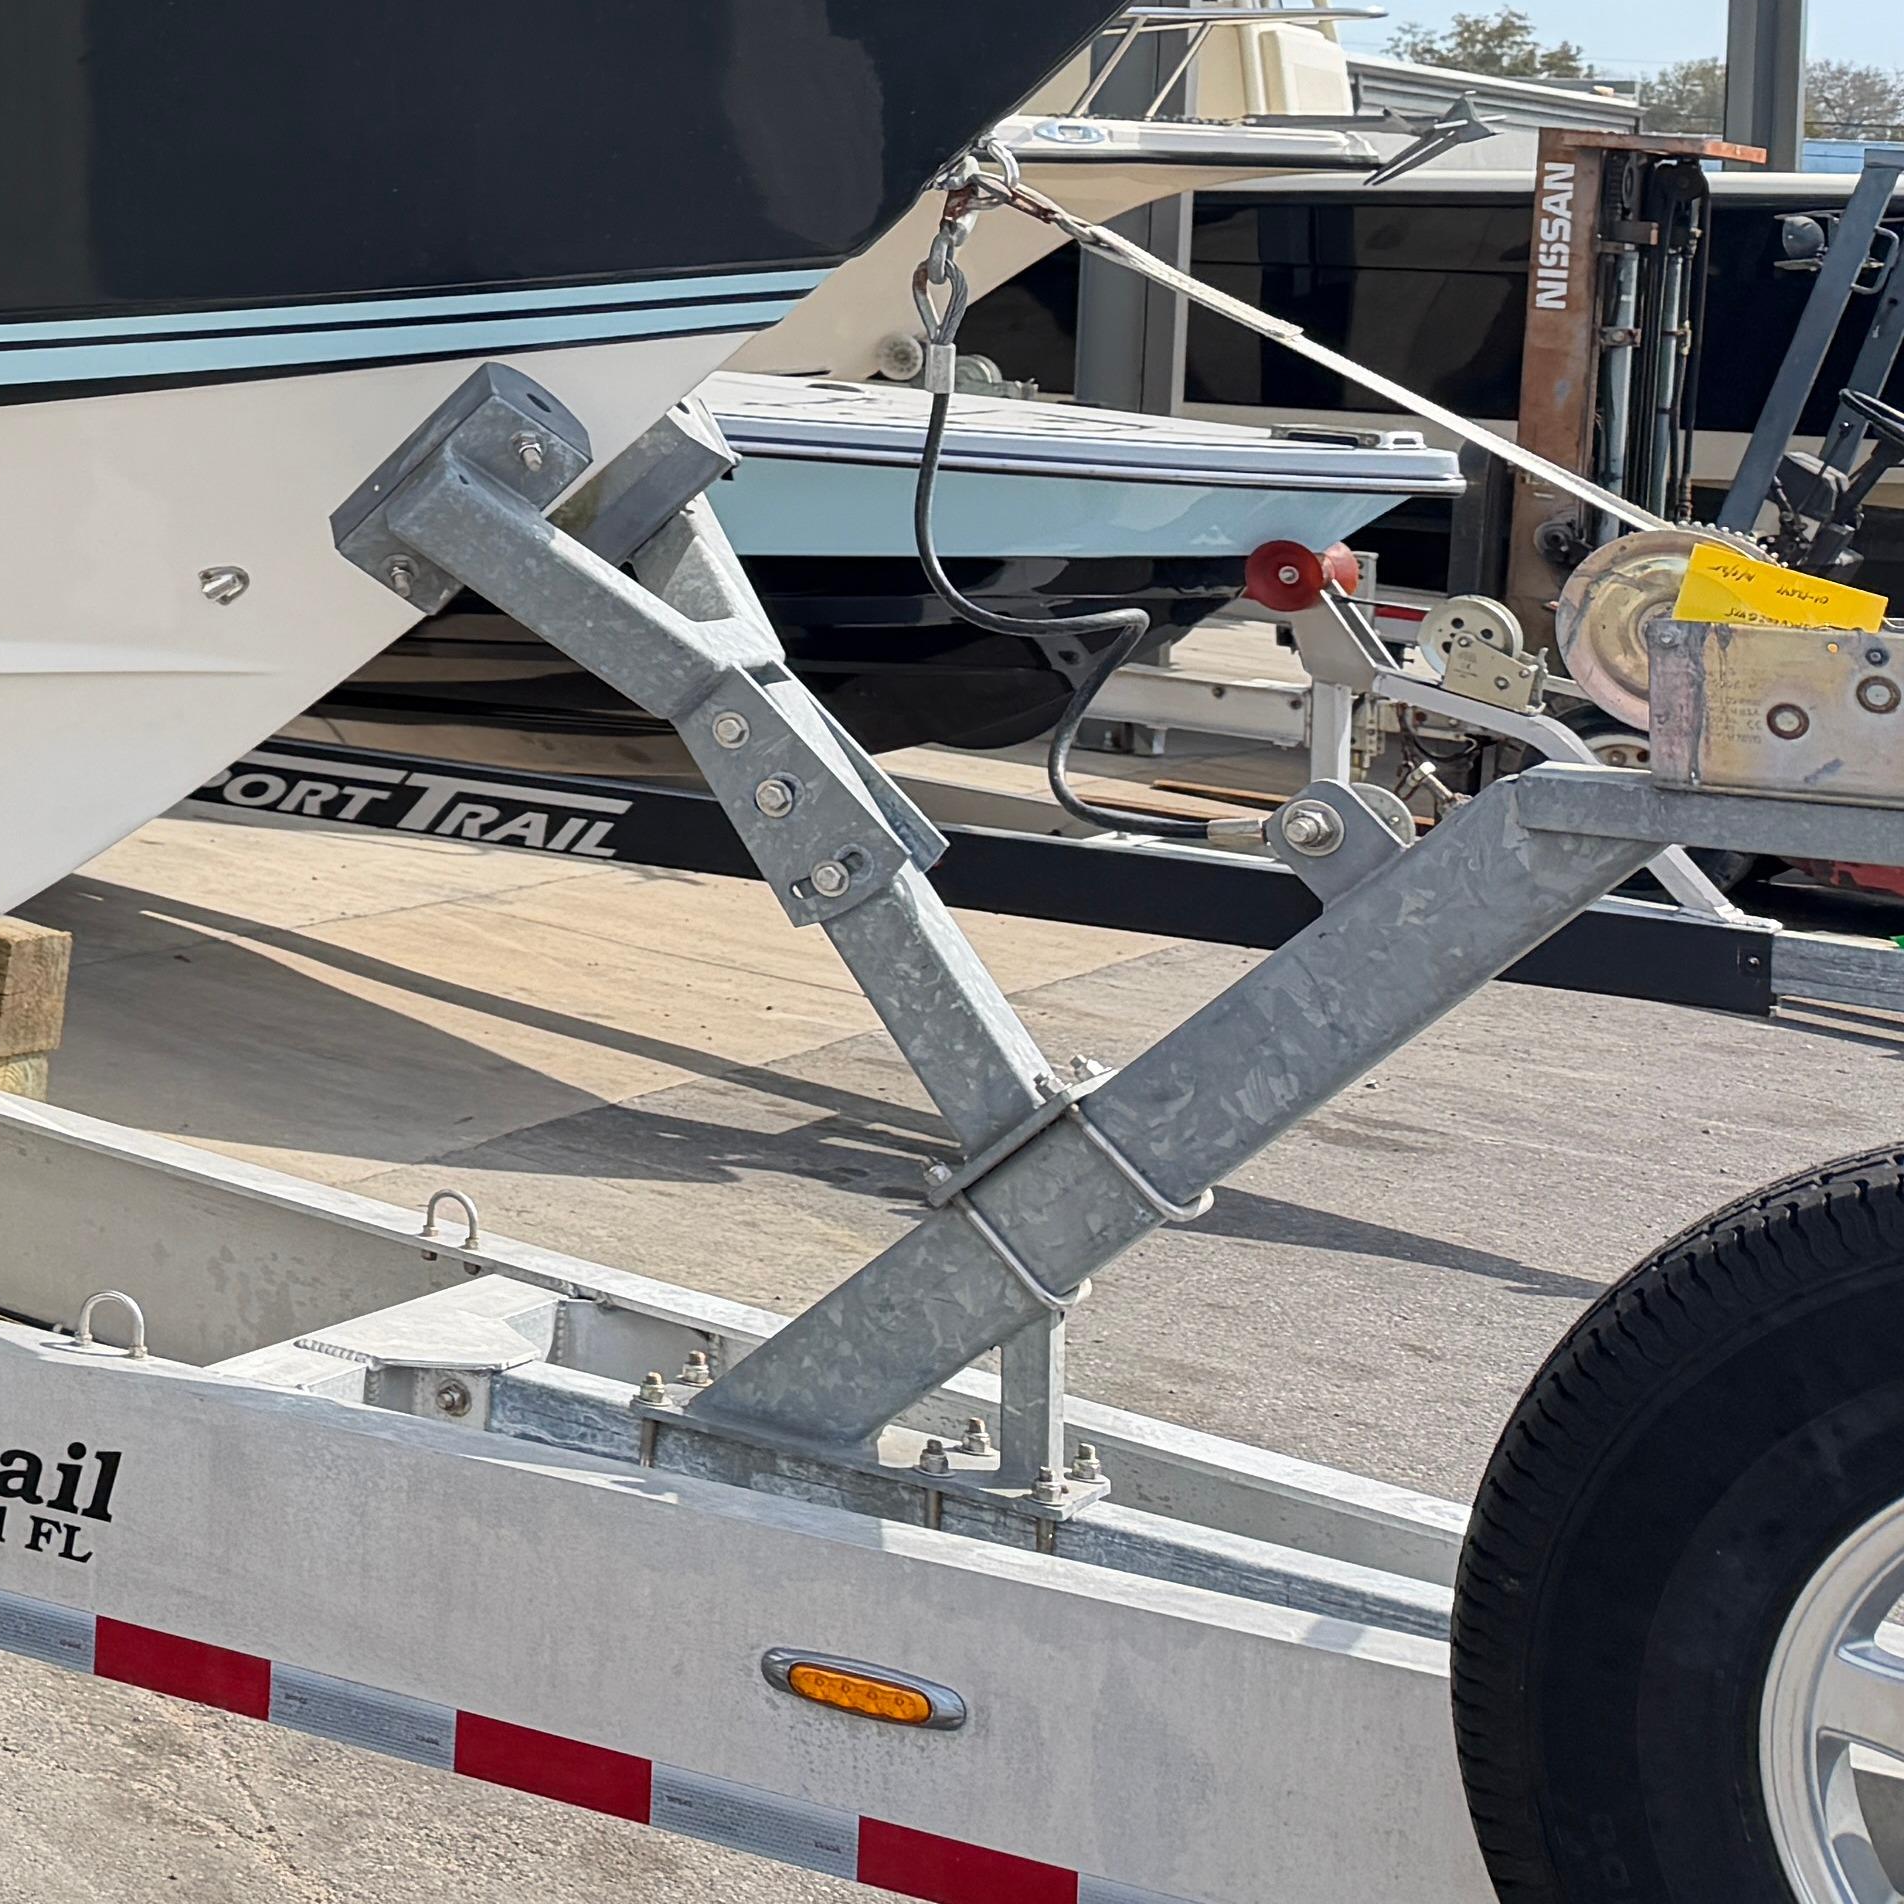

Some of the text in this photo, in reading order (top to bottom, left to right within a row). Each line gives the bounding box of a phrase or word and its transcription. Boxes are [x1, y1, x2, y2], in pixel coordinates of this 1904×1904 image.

[1535, 161, 1576, 310] NISSAN
[395, 769, 634, 858] TRAIL
[25, 1516, 95, 1564] FL
